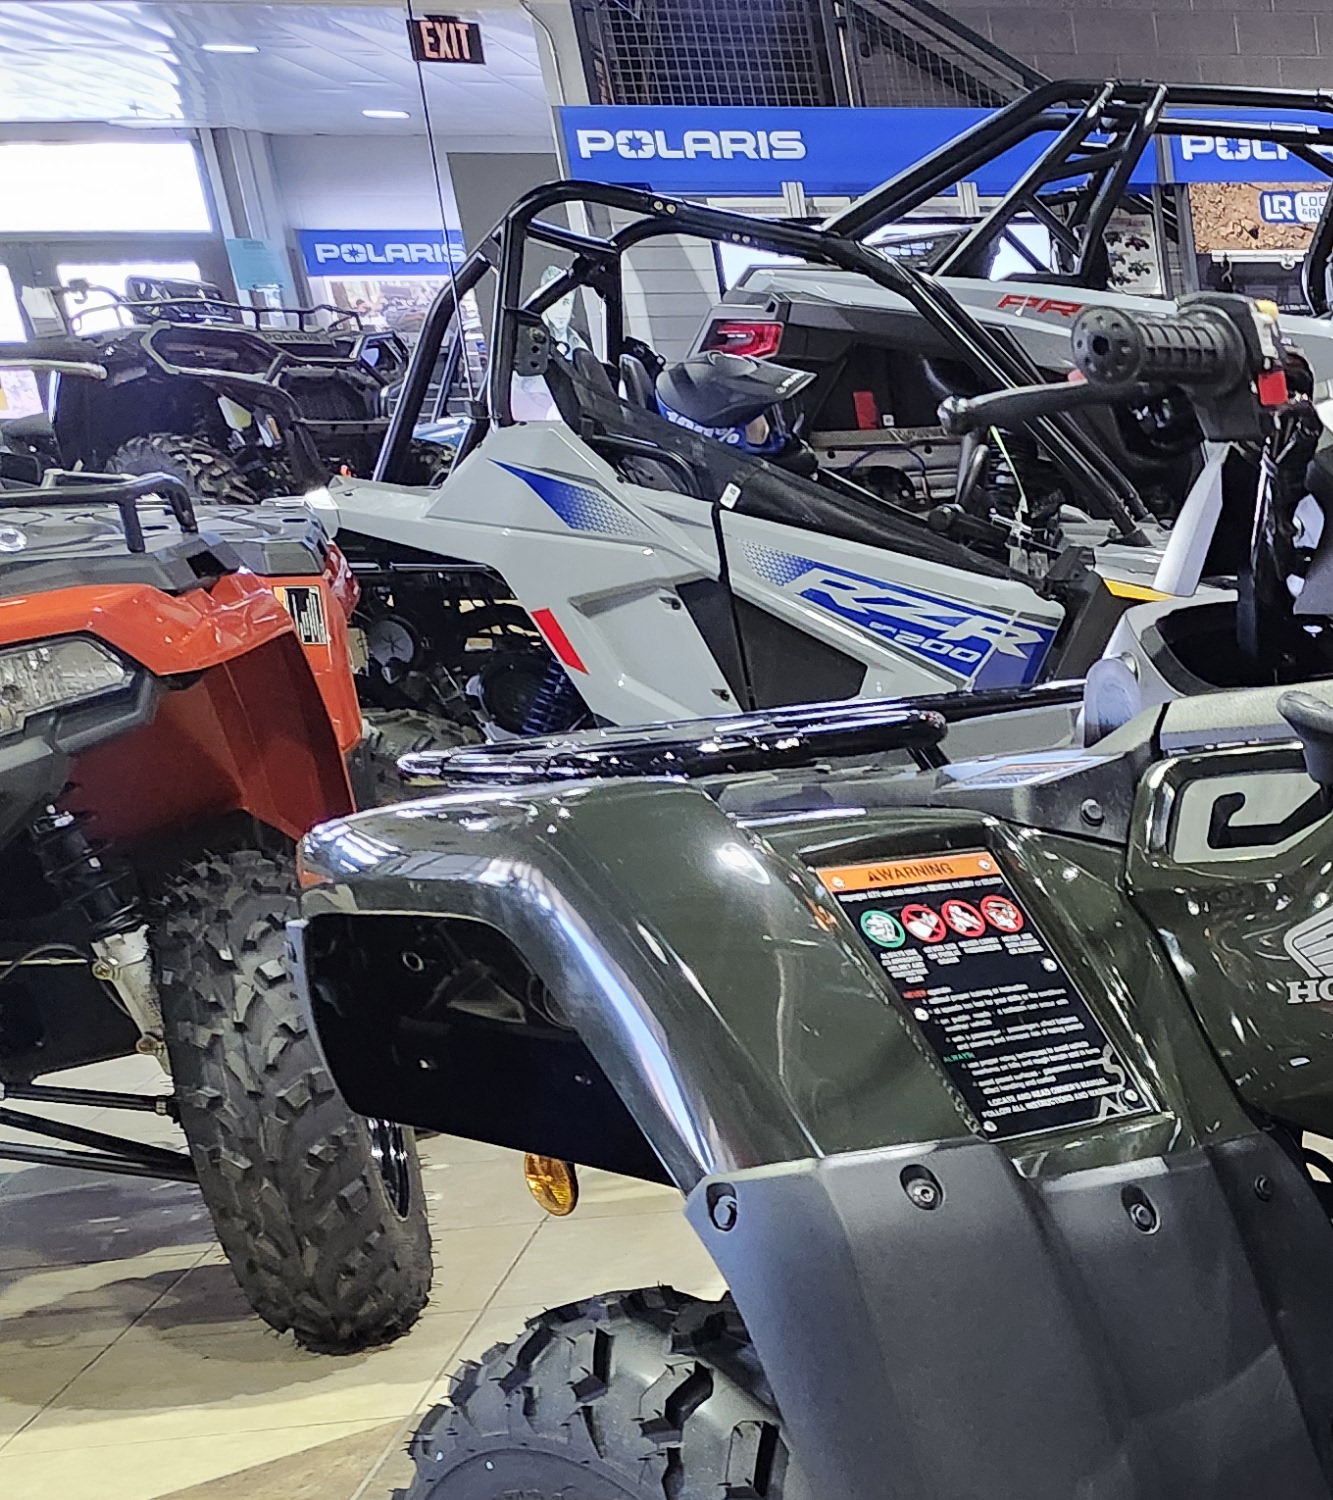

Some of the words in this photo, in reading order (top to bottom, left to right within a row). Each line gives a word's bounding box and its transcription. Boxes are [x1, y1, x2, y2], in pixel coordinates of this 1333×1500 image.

[421, 22, 470, 60] EXIT
[577, 130, 806, 160] POLARIS
[1263, 195, 1295, 220] LR
[315, 242, 467, 264] POLARIS
[784, 567, 1044, 659] RZR
[878, 863, 955, 882] WARNING
